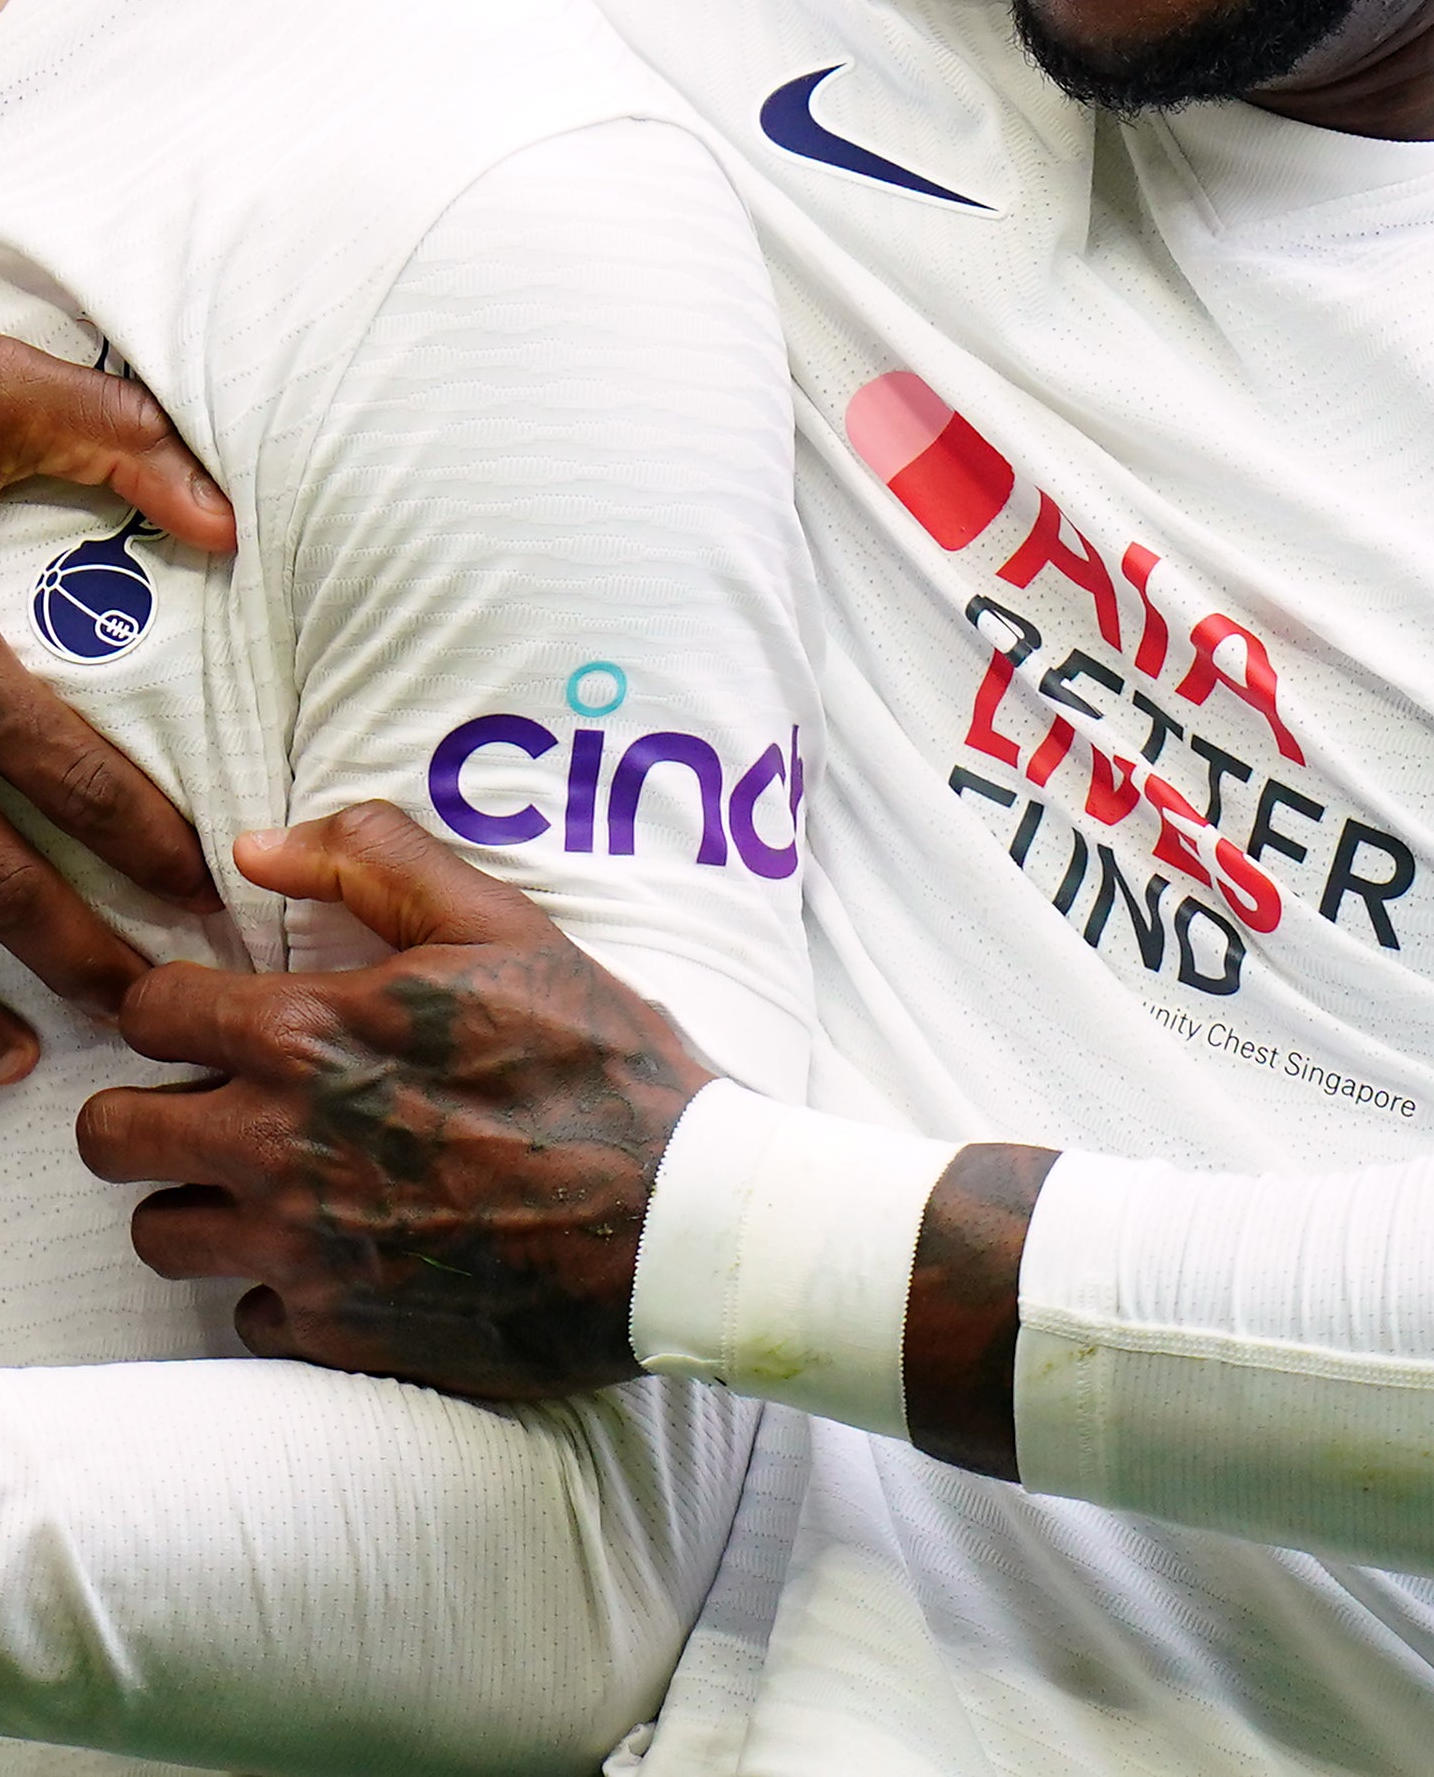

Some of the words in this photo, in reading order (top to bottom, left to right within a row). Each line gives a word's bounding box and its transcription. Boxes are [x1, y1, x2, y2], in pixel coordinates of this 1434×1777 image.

[996, 486, 1306, 767] AIA
[1207, 1022, 1280, 1069] Chest
[1284, 1051, 1418, 1119] Singapore
